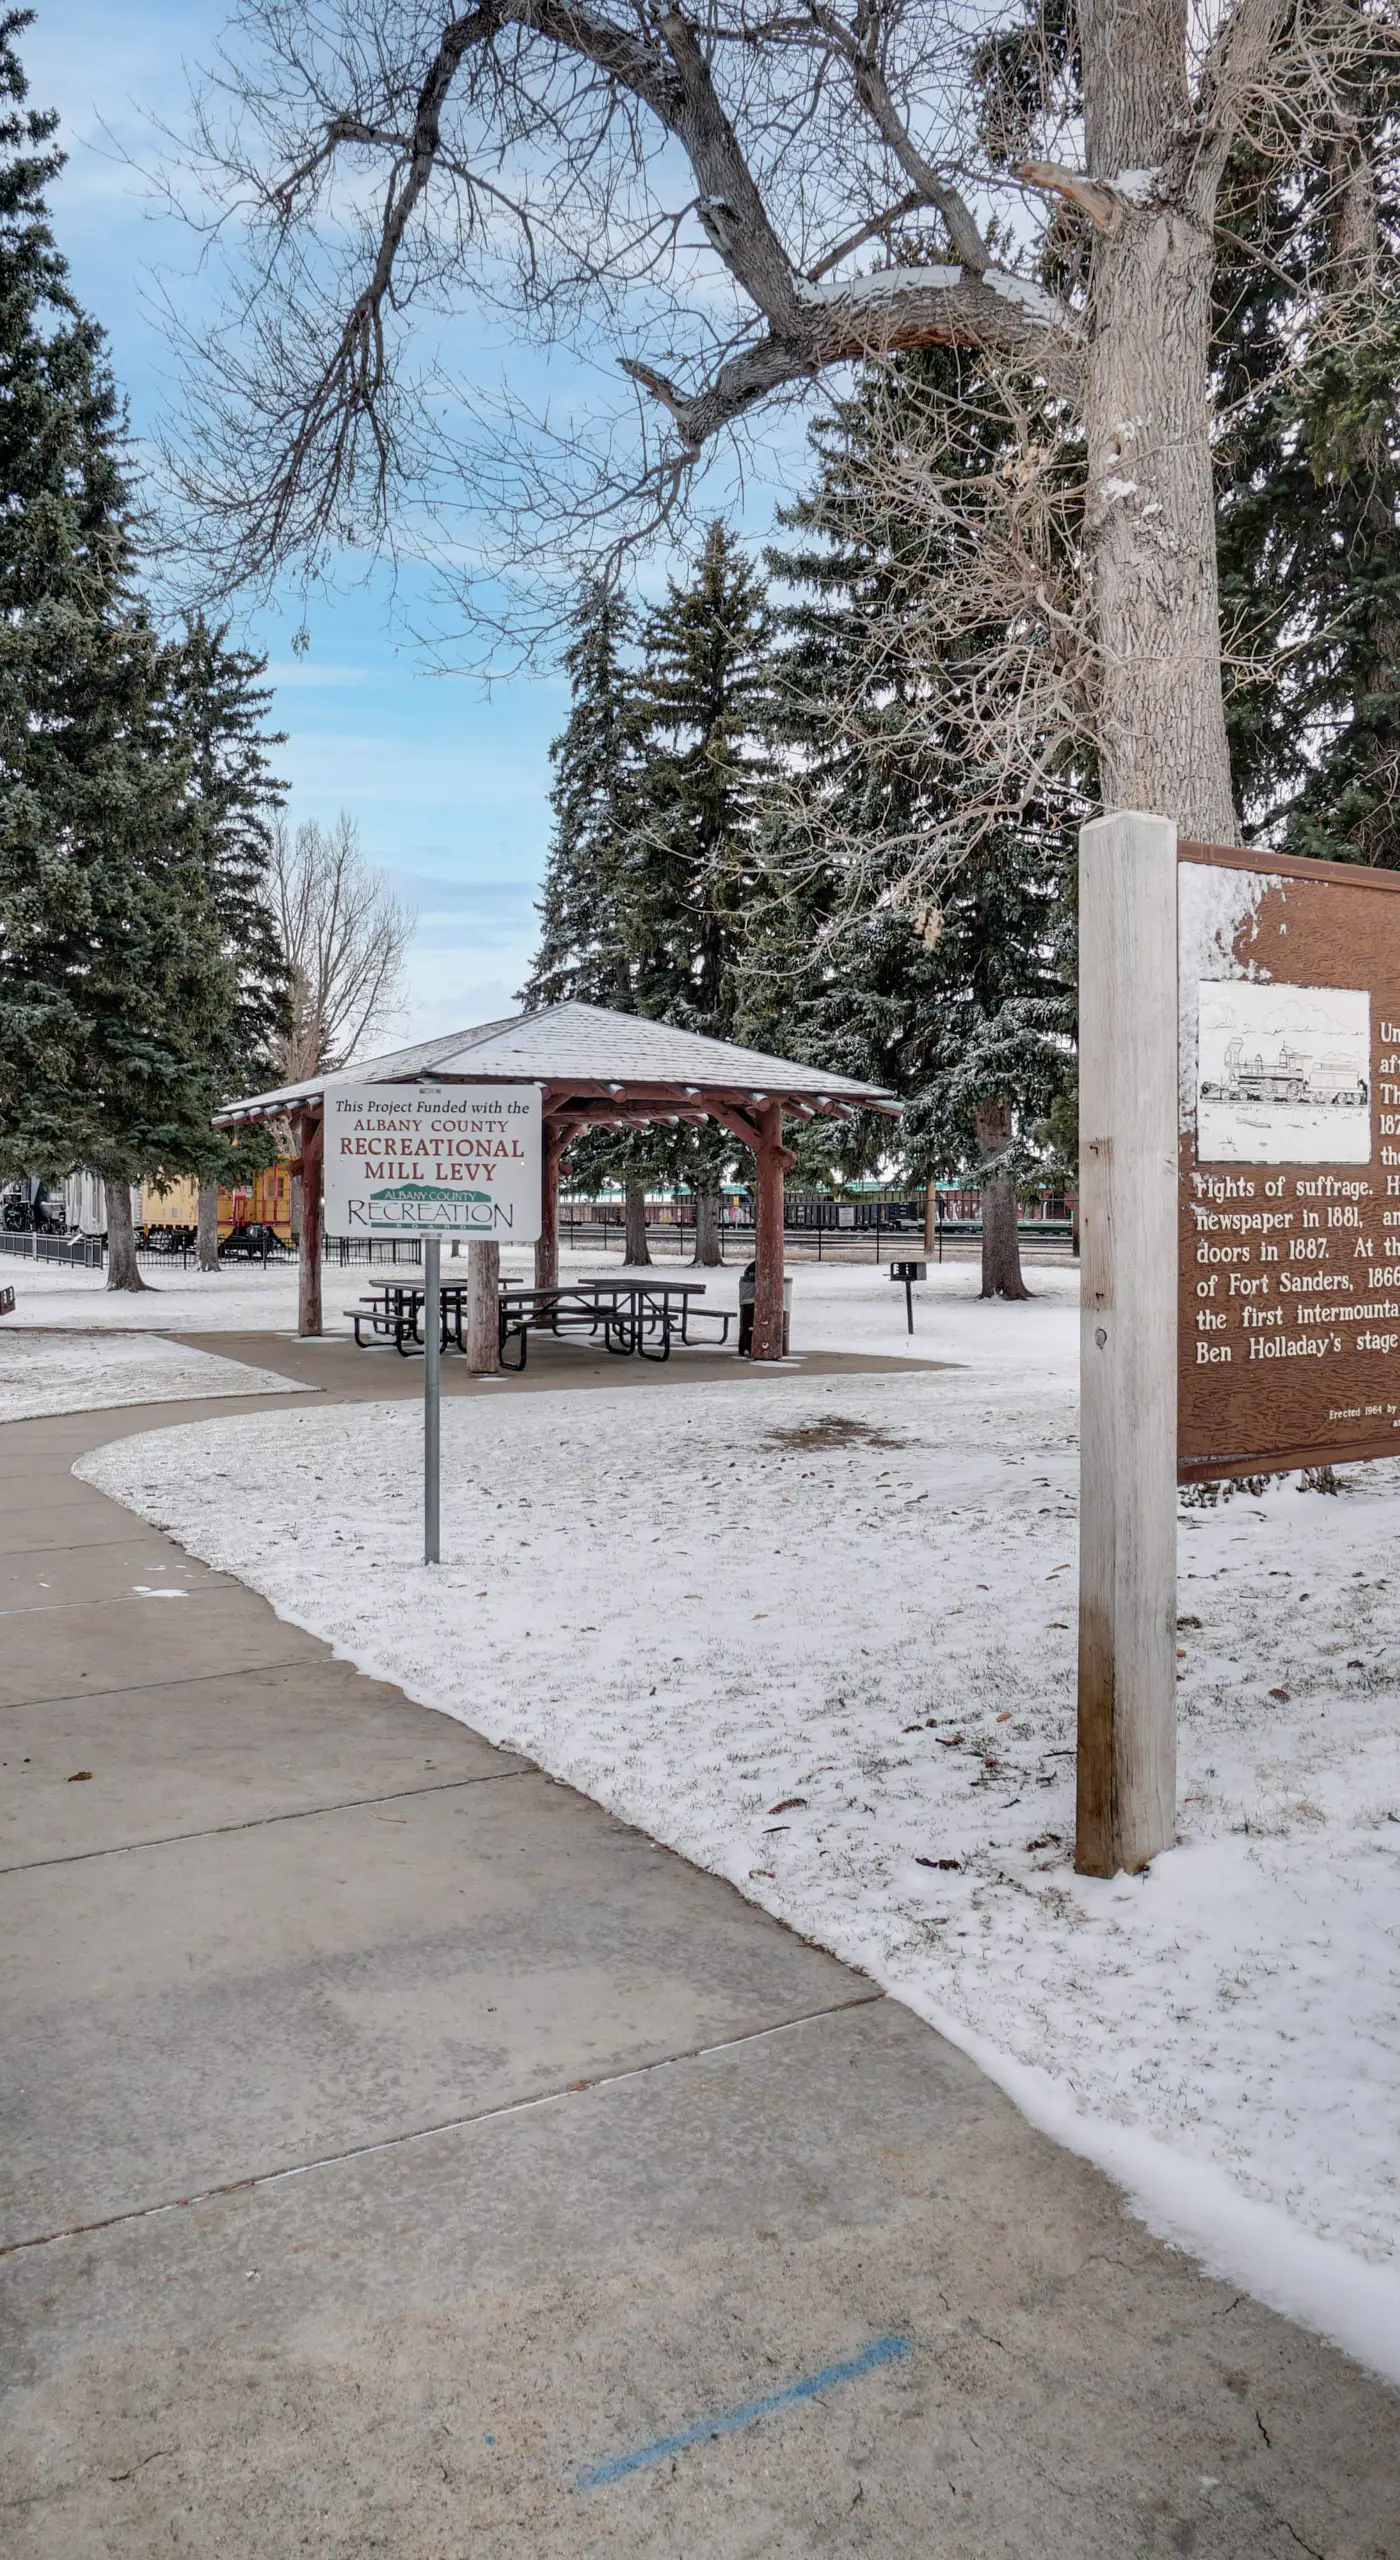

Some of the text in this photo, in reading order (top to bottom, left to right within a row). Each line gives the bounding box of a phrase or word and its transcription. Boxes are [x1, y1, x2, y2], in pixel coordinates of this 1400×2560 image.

[336, 1100, 530, 1116] This Project Funded with the
[354, 1119, 509, 1133] ALBANY COUNTY
[340, 1137, 525, 1157] RECREATIONAL
[364, 1161, 497, 1181] MILL LEVY
[385, 1191, 477, 1201] ALBANY COUNTY
[1197, 1176, 1255, 1203] rights
[1265, 1177, 1286, 1198] of
[1296, 1176, 1374, 1201] suffrage.
[348, 1200, 514, 1229] RECREATION
[1196, 1212, 1294, 1235] newspaper
[1302, 1209, 1320, 1228] in
[1327, 1206, 1364, 1229] 1881,
[1197, 1242, 1250, 1264] doors
[1260, 1241, 1278, 1261] in
[1289, 1237, 1329, 1260] 1887.
[1353, 1237, 1374, 1258] At
[1197, 1275, 1219, 1298] of
[1229, 1273, 1269, 1296] Fort
[1280, 1271, 1354, 1293] Sanders,
[1196, 1299, 1400, 1331] the first intermounta
[1196, 1331, 1398, 1364] Ben Holladay's stage
[1329, 1408, 1361, 1420] Erected
[1387, 1404, 1397, 1414] by
